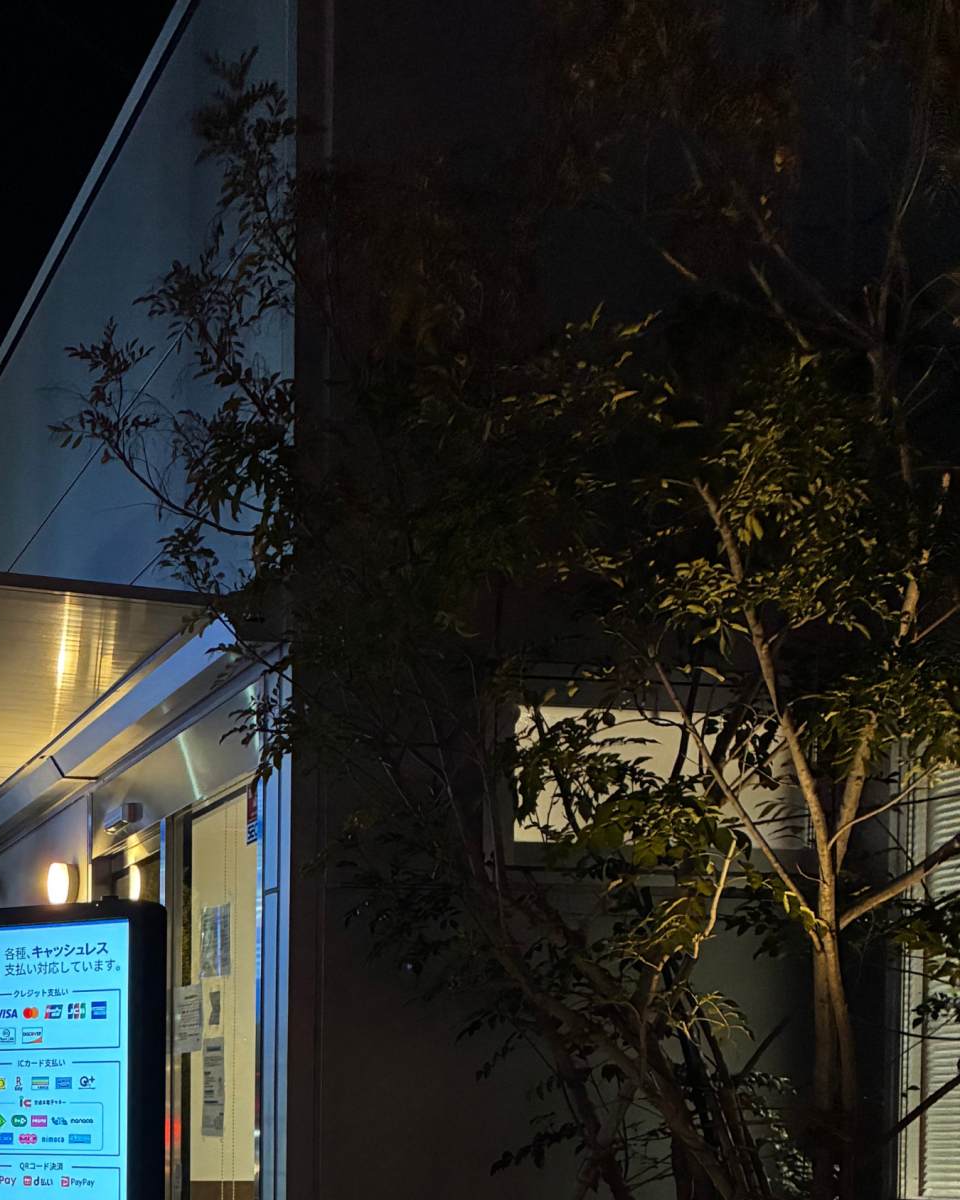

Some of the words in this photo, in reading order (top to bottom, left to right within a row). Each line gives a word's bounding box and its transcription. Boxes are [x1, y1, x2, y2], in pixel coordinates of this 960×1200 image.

[5, 942, 109, 961] 各種、キャッシュレス
[5, 959, 121, 977] 支払い対応しています。
[13, 988, 69, 998] クレジット支払い
[17, 1059, 66, 1068] ICカード支払い
[42, 1135, 65, 1143] nimoca
[19, 1162, 64, 1171] QRコード決済
[0, 1176, 17, 1186] Pay
[33, 1176, 53, 1186] d払い
[70, 1177, 95, 1188] PayPay
